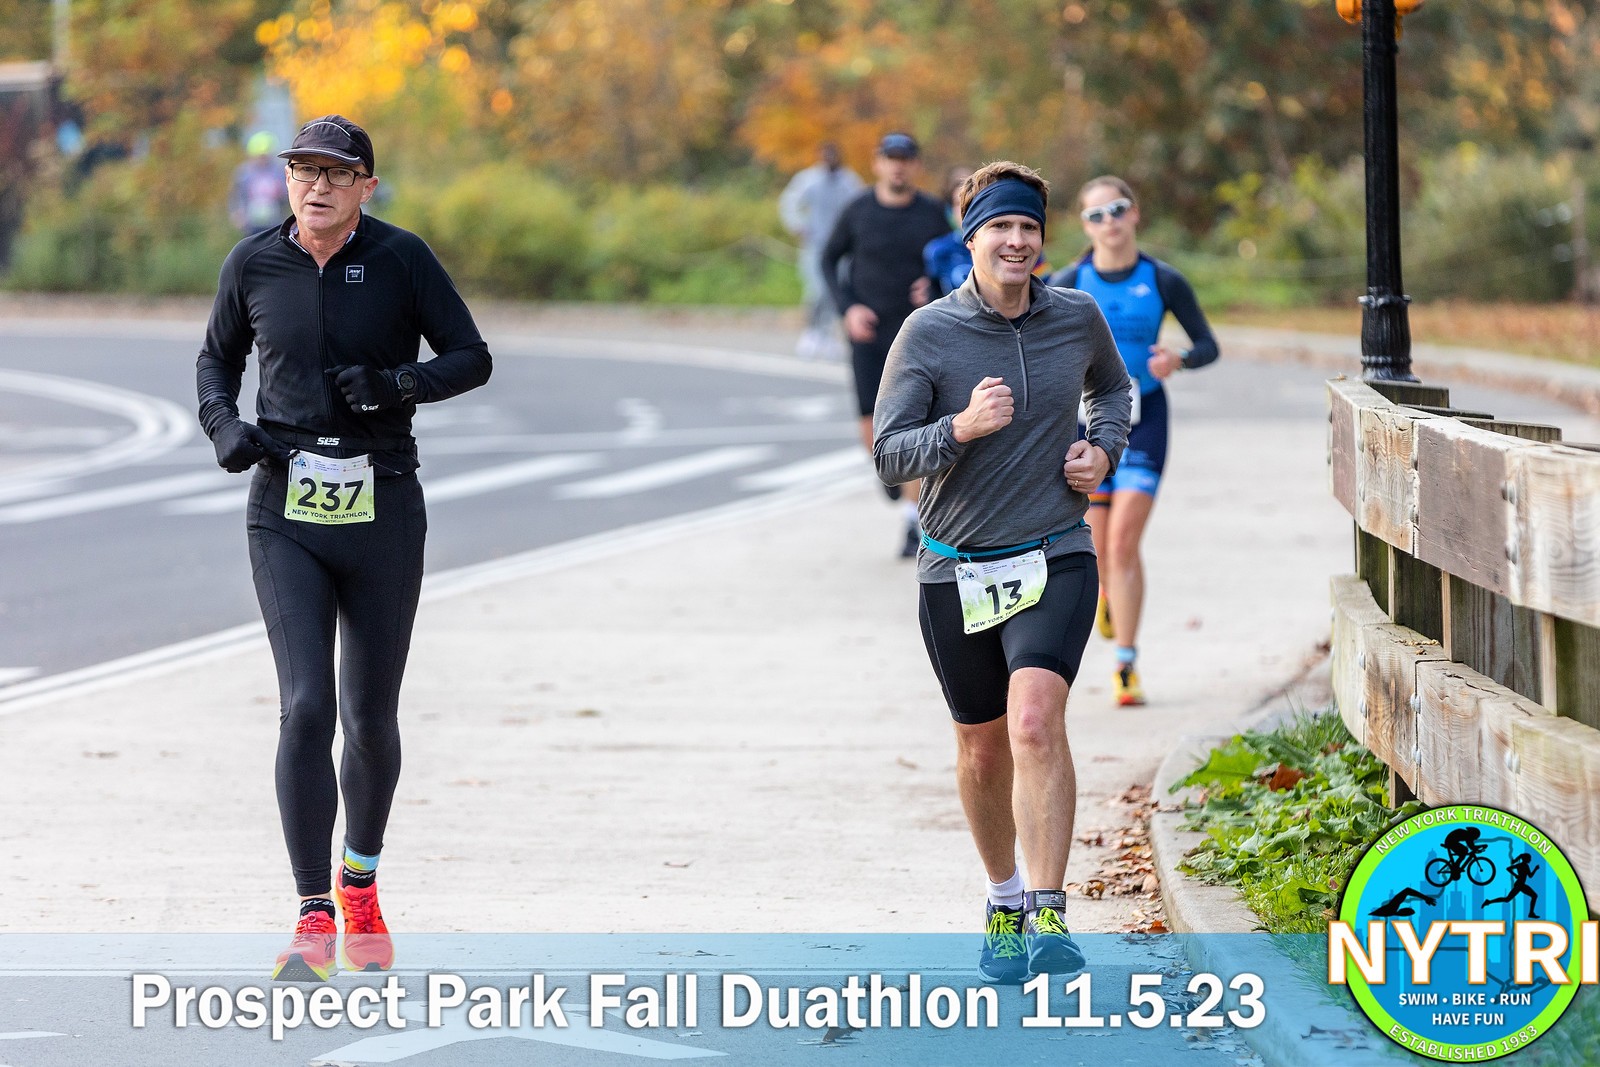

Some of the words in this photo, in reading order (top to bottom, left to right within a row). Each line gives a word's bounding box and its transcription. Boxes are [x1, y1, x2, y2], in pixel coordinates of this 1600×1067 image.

[297, 477, 364, 512] 237
[291, 508, 309, 516] NEW
[310, 511, 328, 519] YORK
[330, 510, 368, 519] TRIATHLON
[984, 579, 1022, 615] 13
[970, 620, 986, 628] NEW
[987, 614, 1005, 624] YORK
